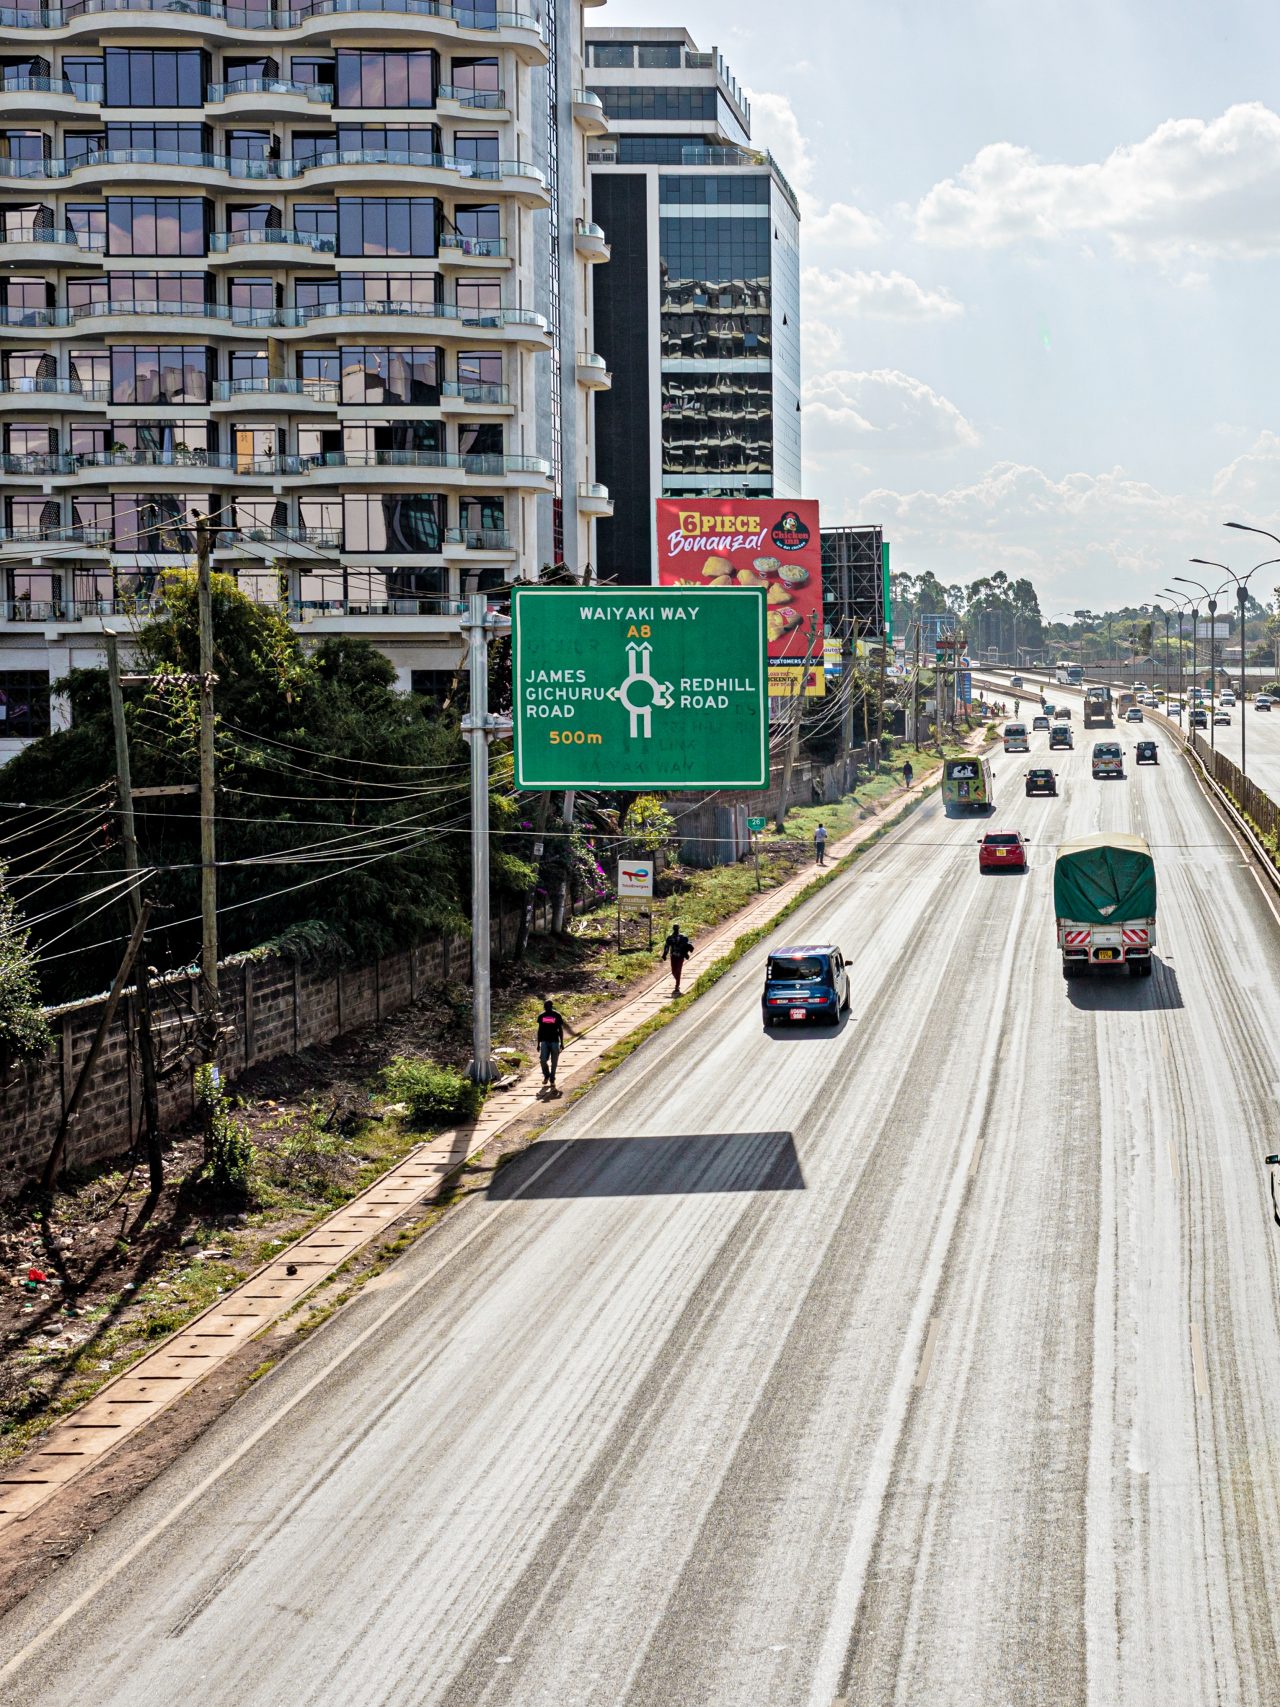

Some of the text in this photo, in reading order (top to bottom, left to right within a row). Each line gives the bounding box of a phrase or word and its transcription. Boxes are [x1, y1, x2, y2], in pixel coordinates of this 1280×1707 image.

[682, 514, 760, 533] 6 PIECE
[772, 530, 809, 540] Chicken
[667, 527, 768, 557] Bonanza!
[580, 607, 700, 620] WAIYAKI WAY
[627, 625, 652, 638] A8
[525, 670, 587, 683] JAMES
[680, 678, 756, 691] REDHILL
[526, 687, 605, 700] GICHURU
[680, 696, 729, 709] ROAD
[526, 705, 575, 718] ROAD
[549, 731, 603, 744] 500m
